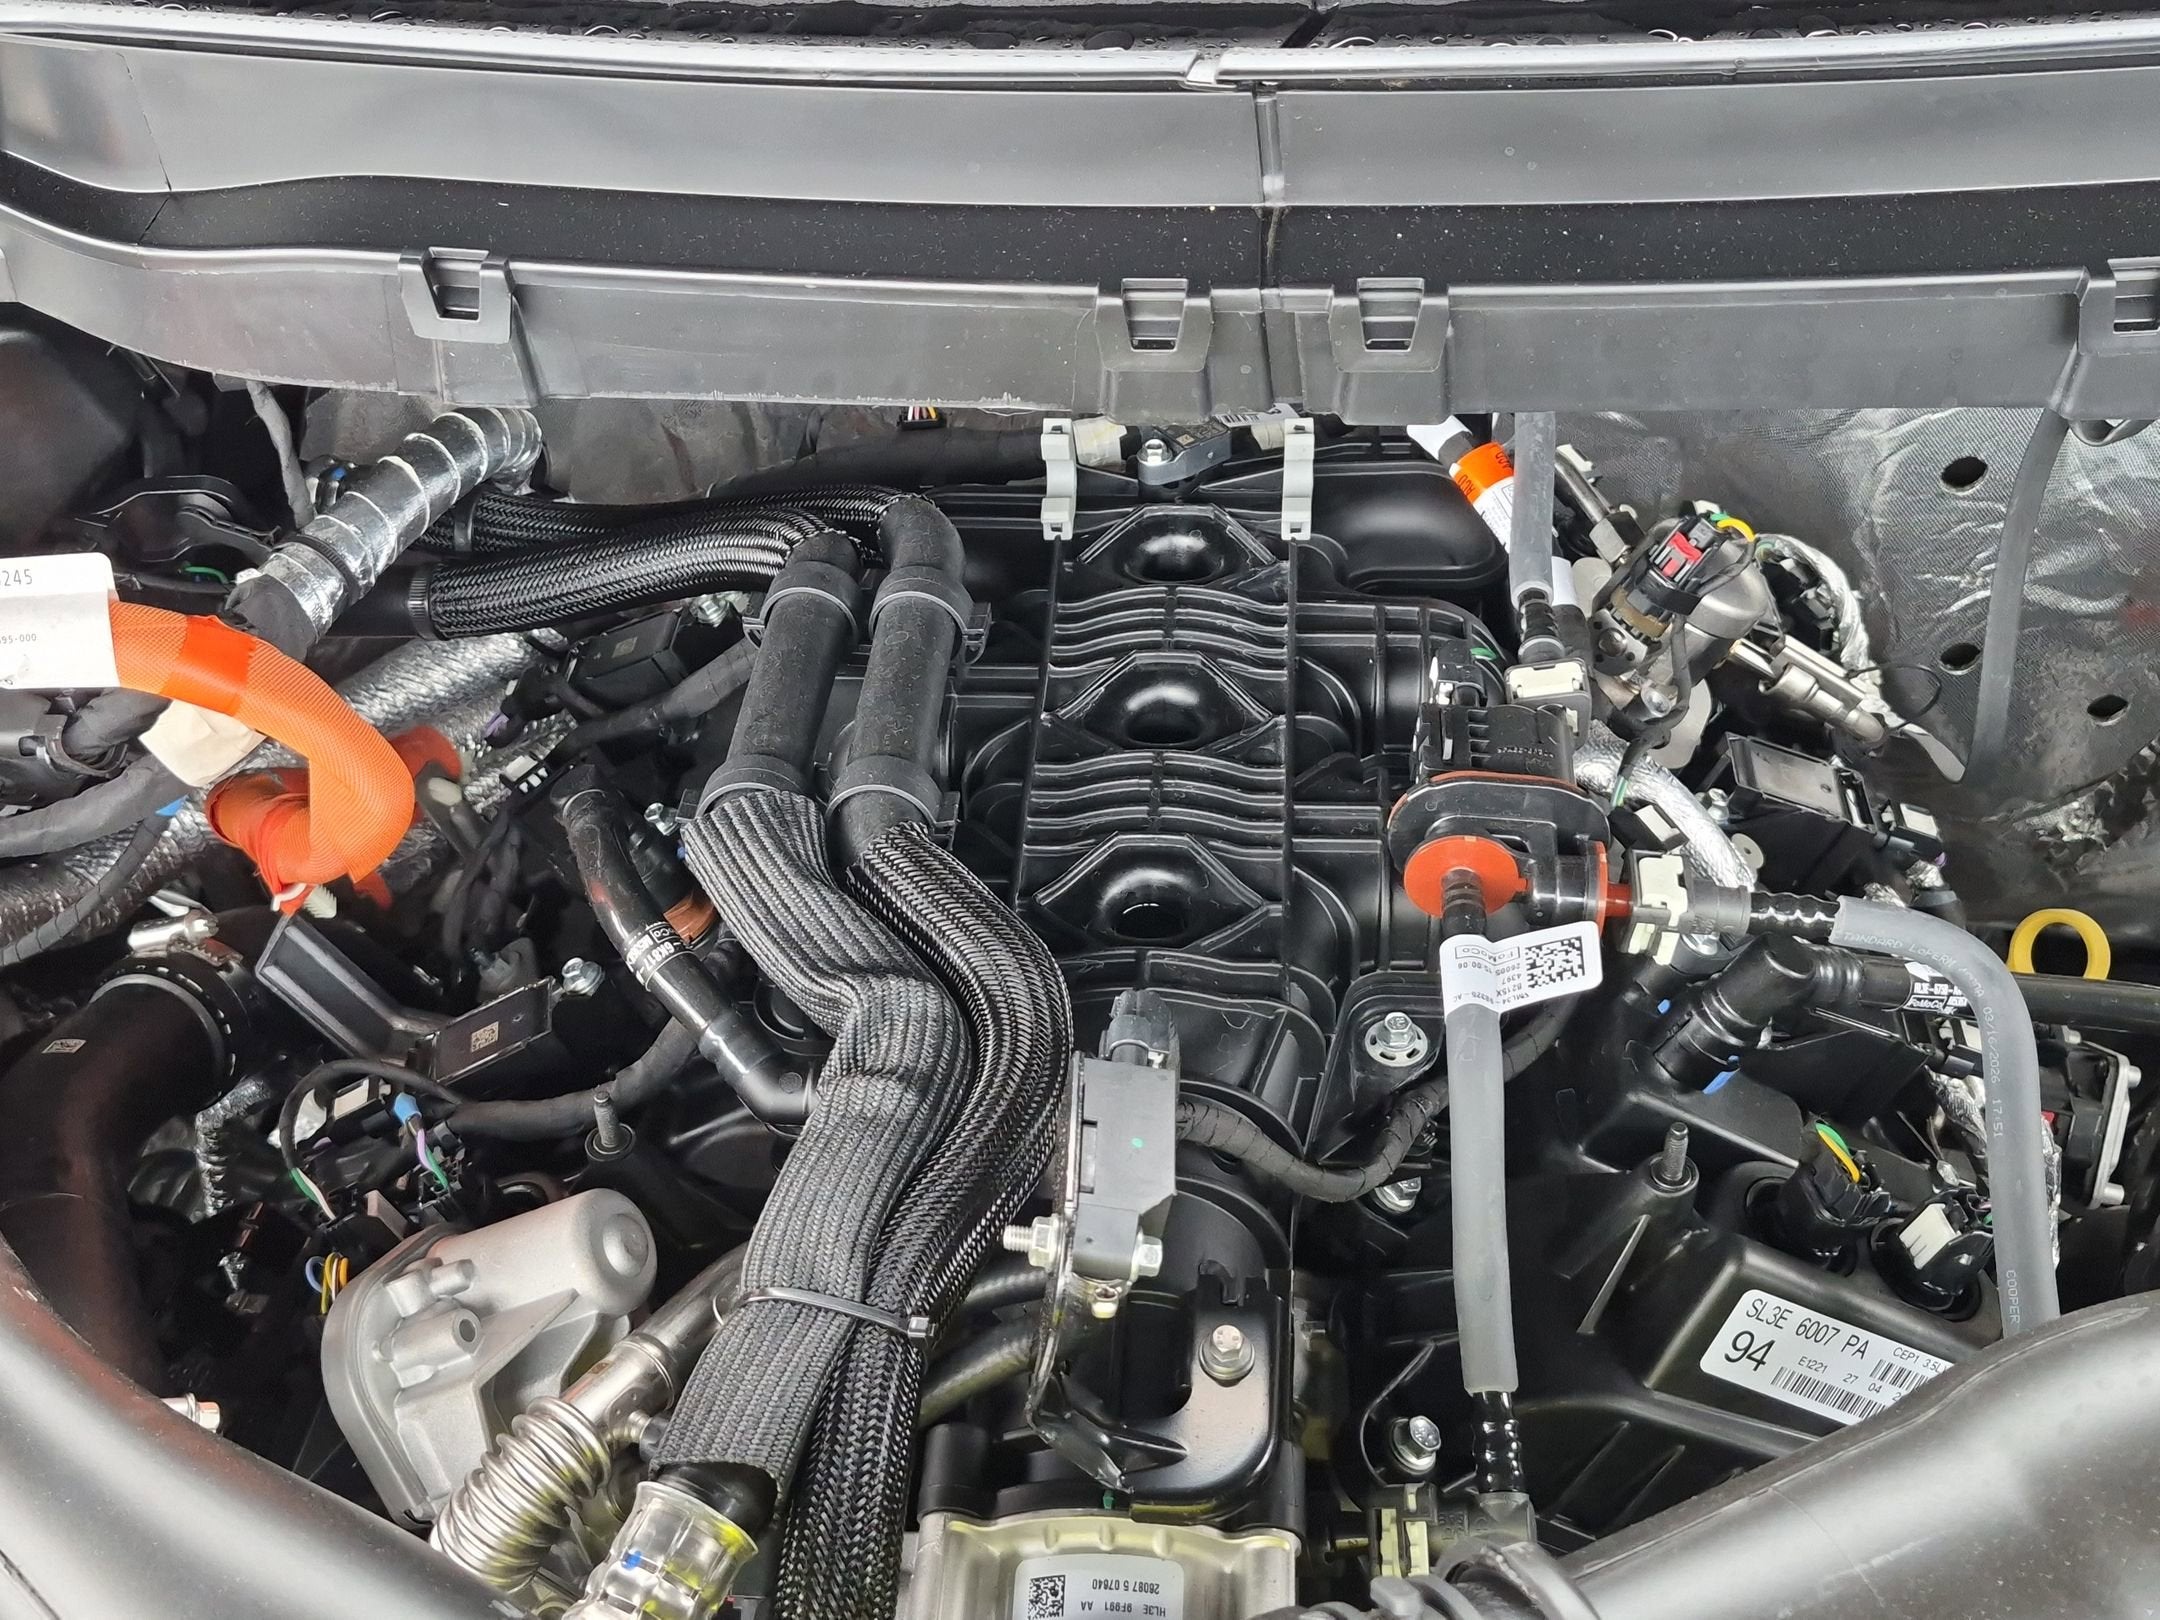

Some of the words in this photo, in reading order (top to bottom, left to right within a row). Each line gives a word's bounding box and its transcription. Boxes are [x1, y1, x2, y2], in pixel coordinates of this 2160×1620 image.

[0, 568, 33, 587] 245
[0, 633, 37, 645] 95-000
[1983, 1006, 2001, 1084] 03/16/2026
[2006, 1269, 2020, 1325] COOPER
[1746, 1298, 1793, 1330] SL3E
[1795, 1317, 1841, 1346] 6007
[1841, 1334, 1870, 1360] PA
[1724, 1330, 1776, 1372] 94
[1893, 1347, 1919, 1364] CEP1
[1798, 1355, 1828, 1374] E1221
[1843, 1373, 1858, 1385] 27
[1868, 1383, 1882, 1394] 04
[1123, 1580, 1129, 1592] 5
[1080, 1600, 1094, 1611] AA
[1143, 1603, 1166, 1617] HL3E
